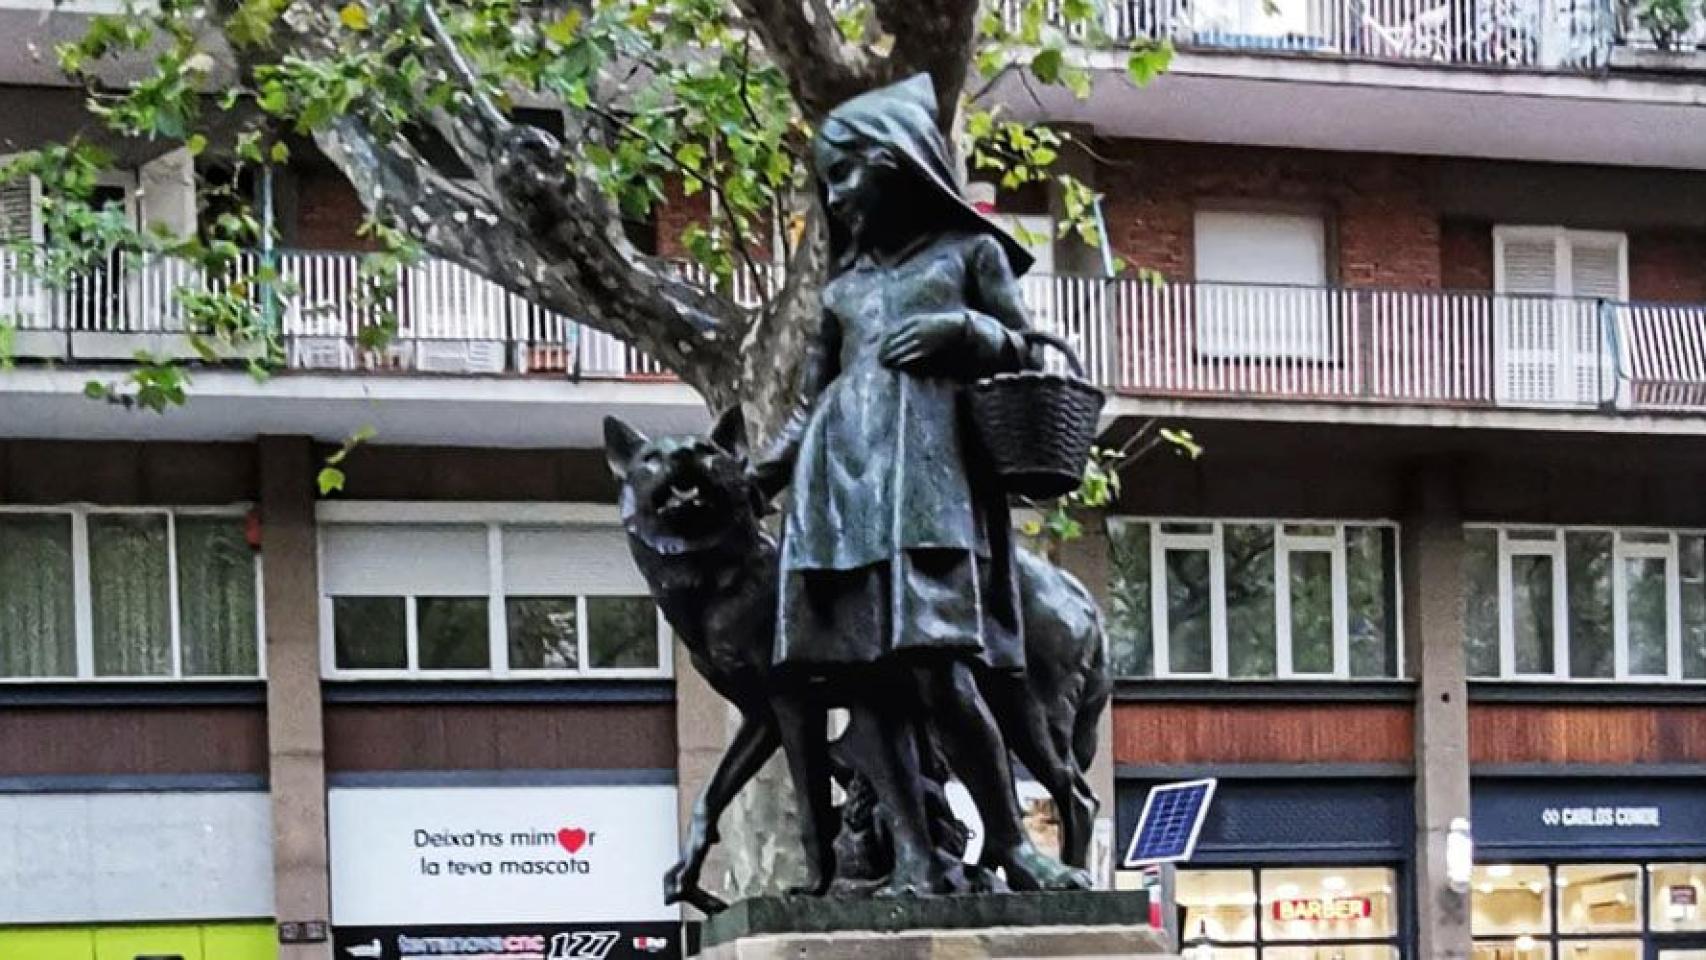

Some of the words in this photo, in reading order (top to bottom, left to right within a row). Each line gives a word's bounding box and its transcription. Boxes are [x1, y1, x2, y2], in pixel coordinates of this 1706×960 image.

[421, 857, 440, 876] la
[448, 859, 493, 875] teva
[500, 858, 590, 875] mascota
[1280, 899, 1363, 920] BARBER
